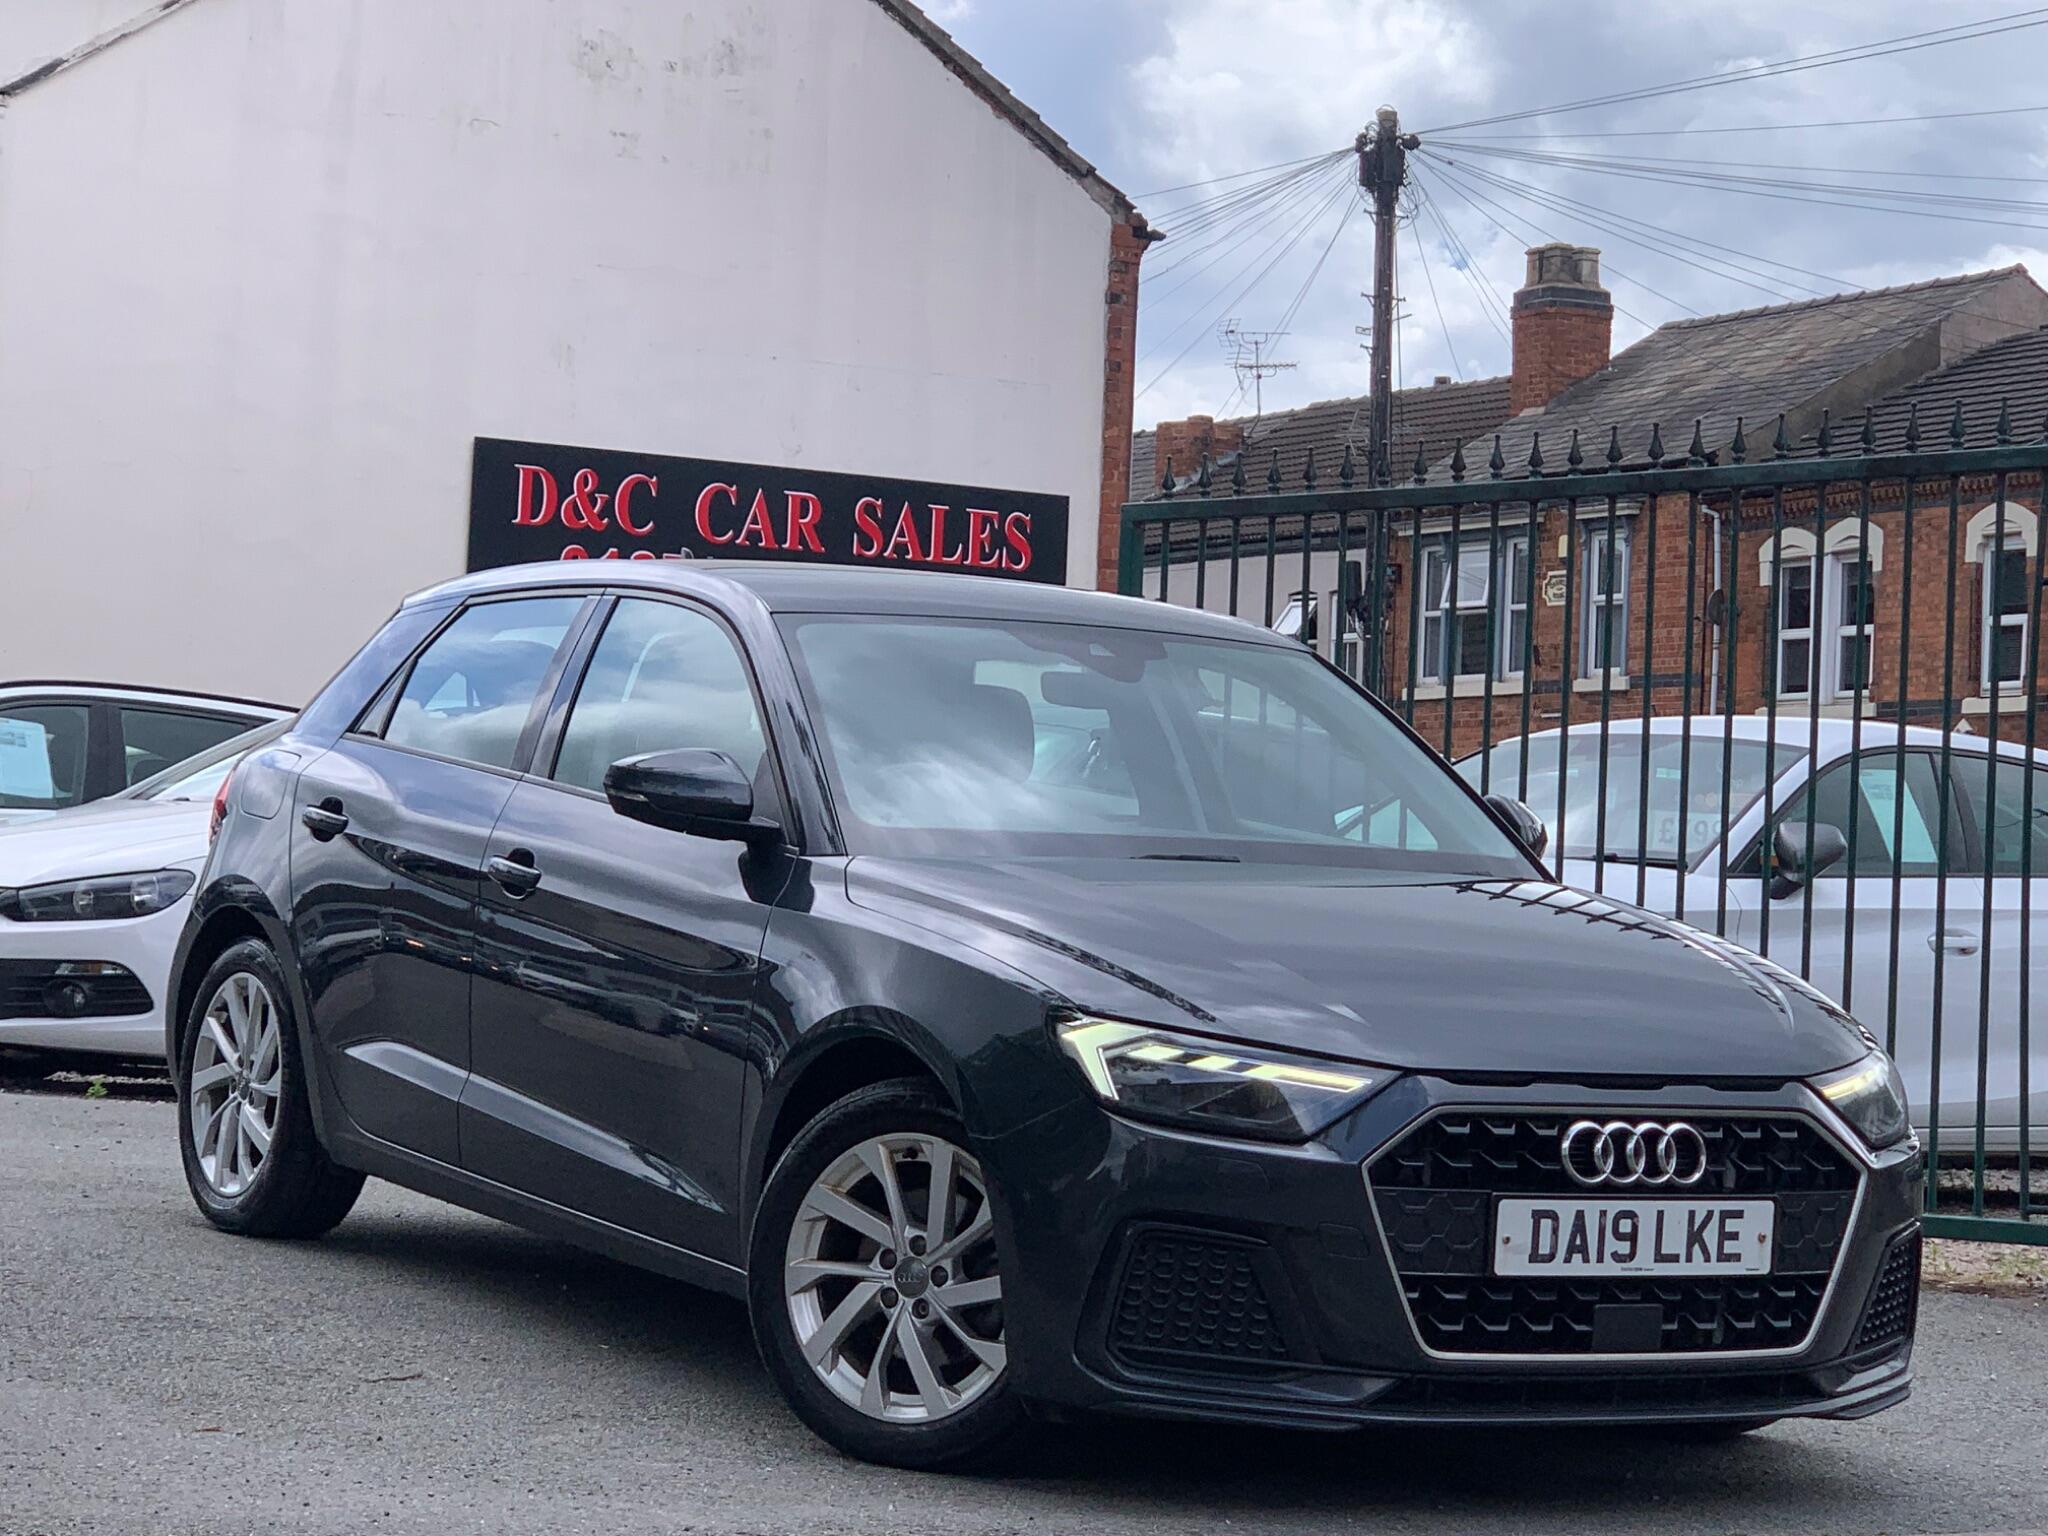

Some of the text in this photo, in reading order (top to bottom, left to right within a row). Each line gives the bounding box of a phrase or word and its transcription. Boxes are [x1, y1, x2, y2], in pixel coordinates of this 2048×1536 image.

[513, 464, 1031, 572] D&C CAR SALES
[1528, 1209, 1745, 1264] DA19 LKE
